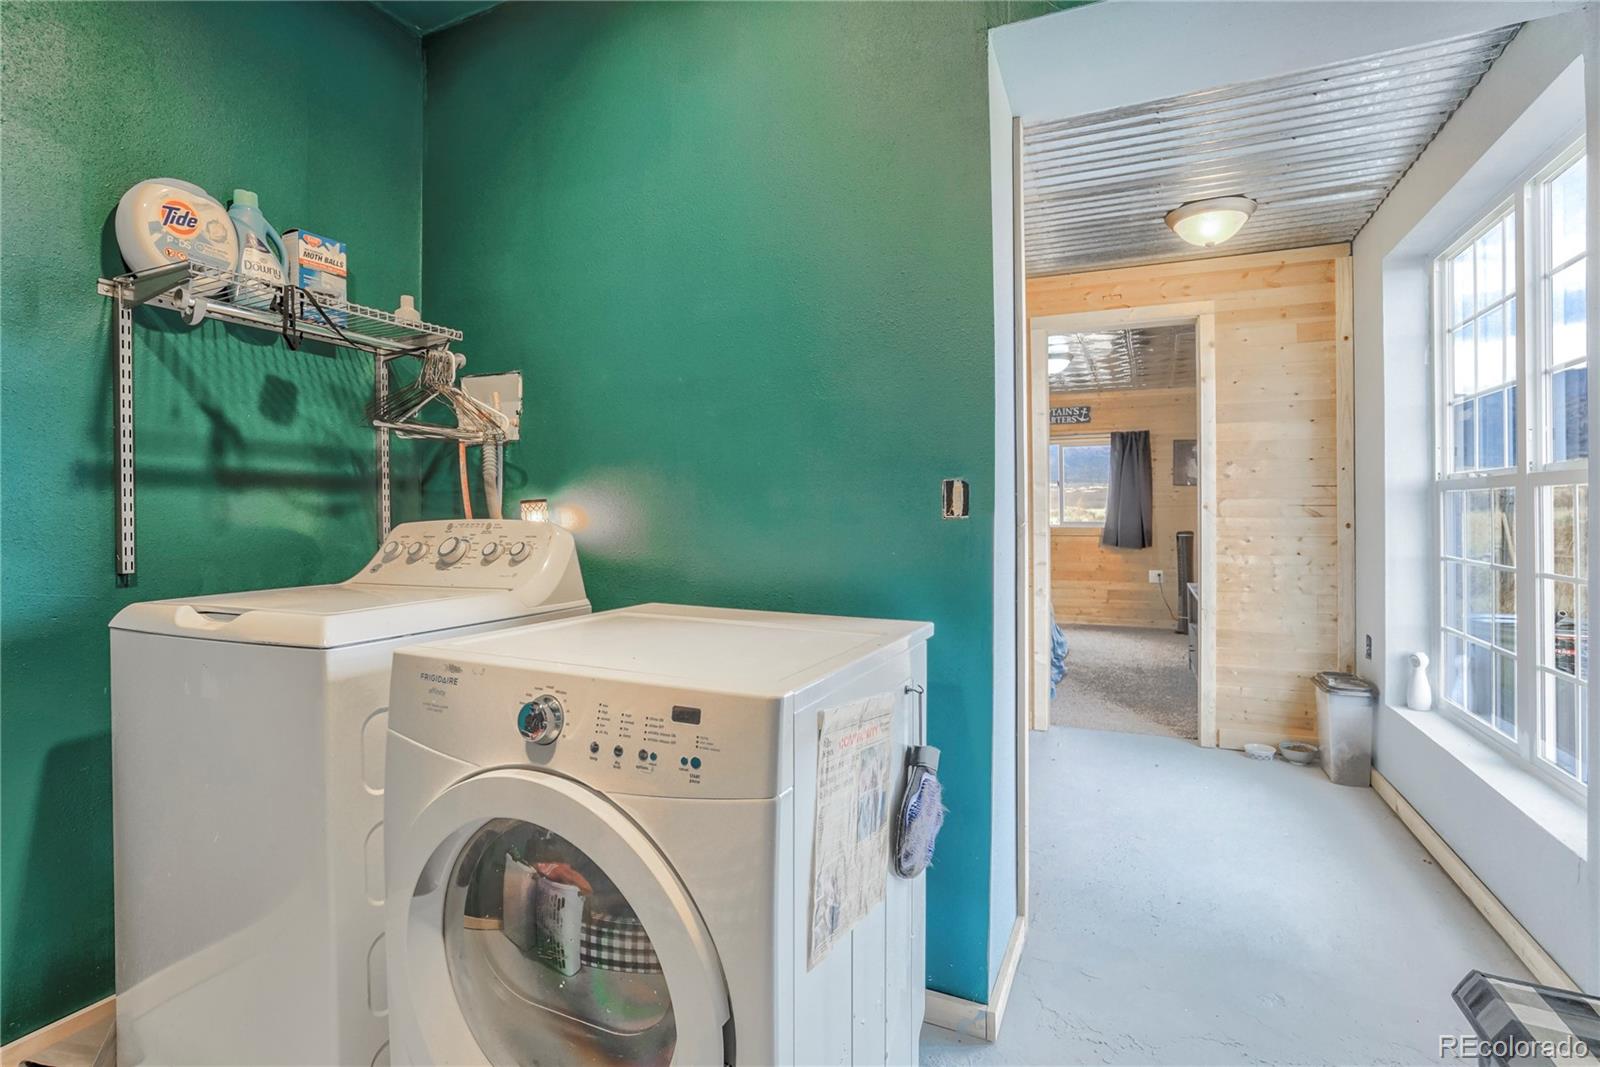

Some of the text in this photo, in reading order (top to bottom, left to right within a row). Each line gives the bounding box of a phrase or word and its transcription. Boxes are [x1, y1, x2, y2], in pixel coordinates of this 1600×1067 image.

[162, 204, 199, 228] Tide
[303, 250, 323, 263] MOTH
[324, 255, 345, 269] BALLS
[243, 259, 282, 281] Downy
[420, 672, 459, 687] FRIGIDAIRE
